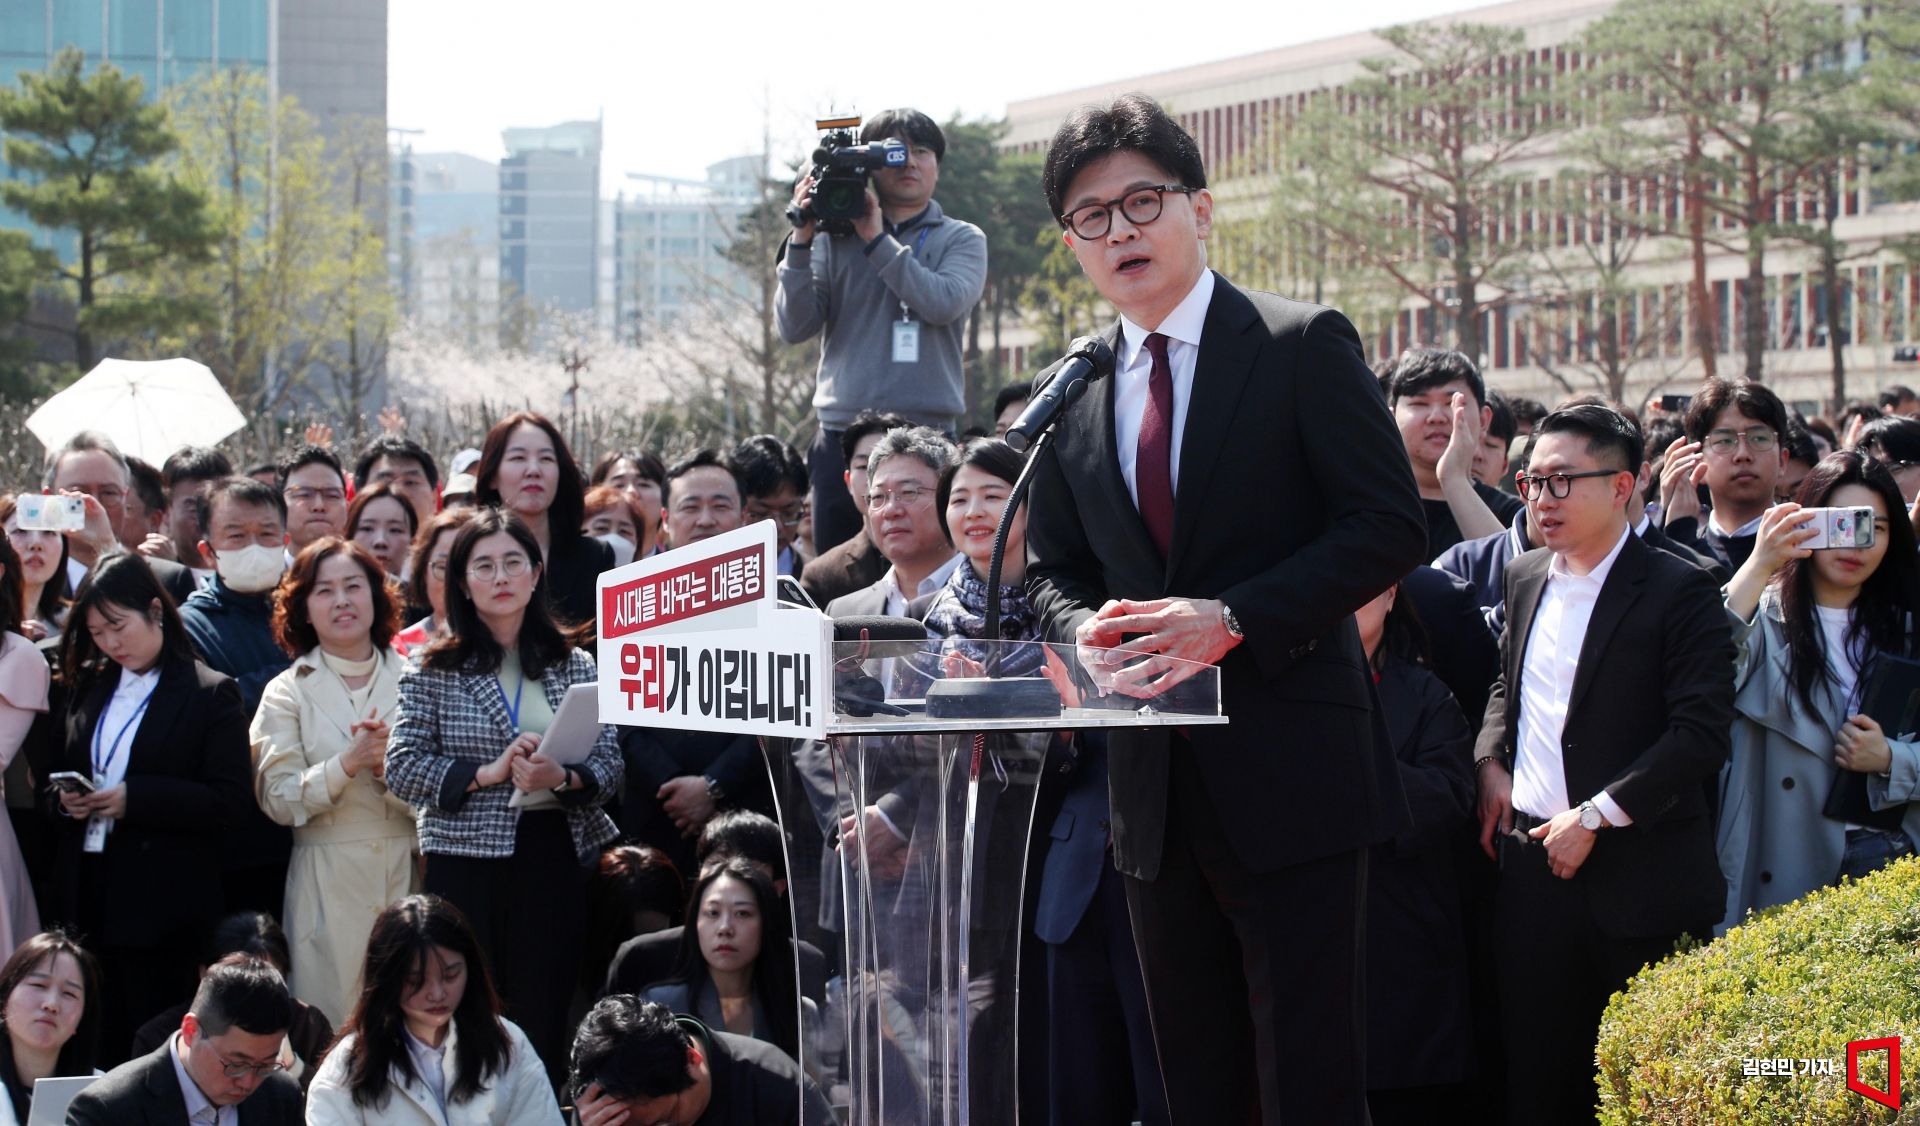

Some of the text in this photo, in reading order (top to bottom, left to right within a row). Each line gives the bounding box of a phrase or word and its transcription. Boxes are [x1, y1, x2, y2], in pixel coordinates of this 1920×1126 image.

[887, 150, 905, 162] CBS
[613, 553, 760, 628] 시대를 바꾸는 대통령
[620, 643, 811, 727] 우리가 이깁니다!
